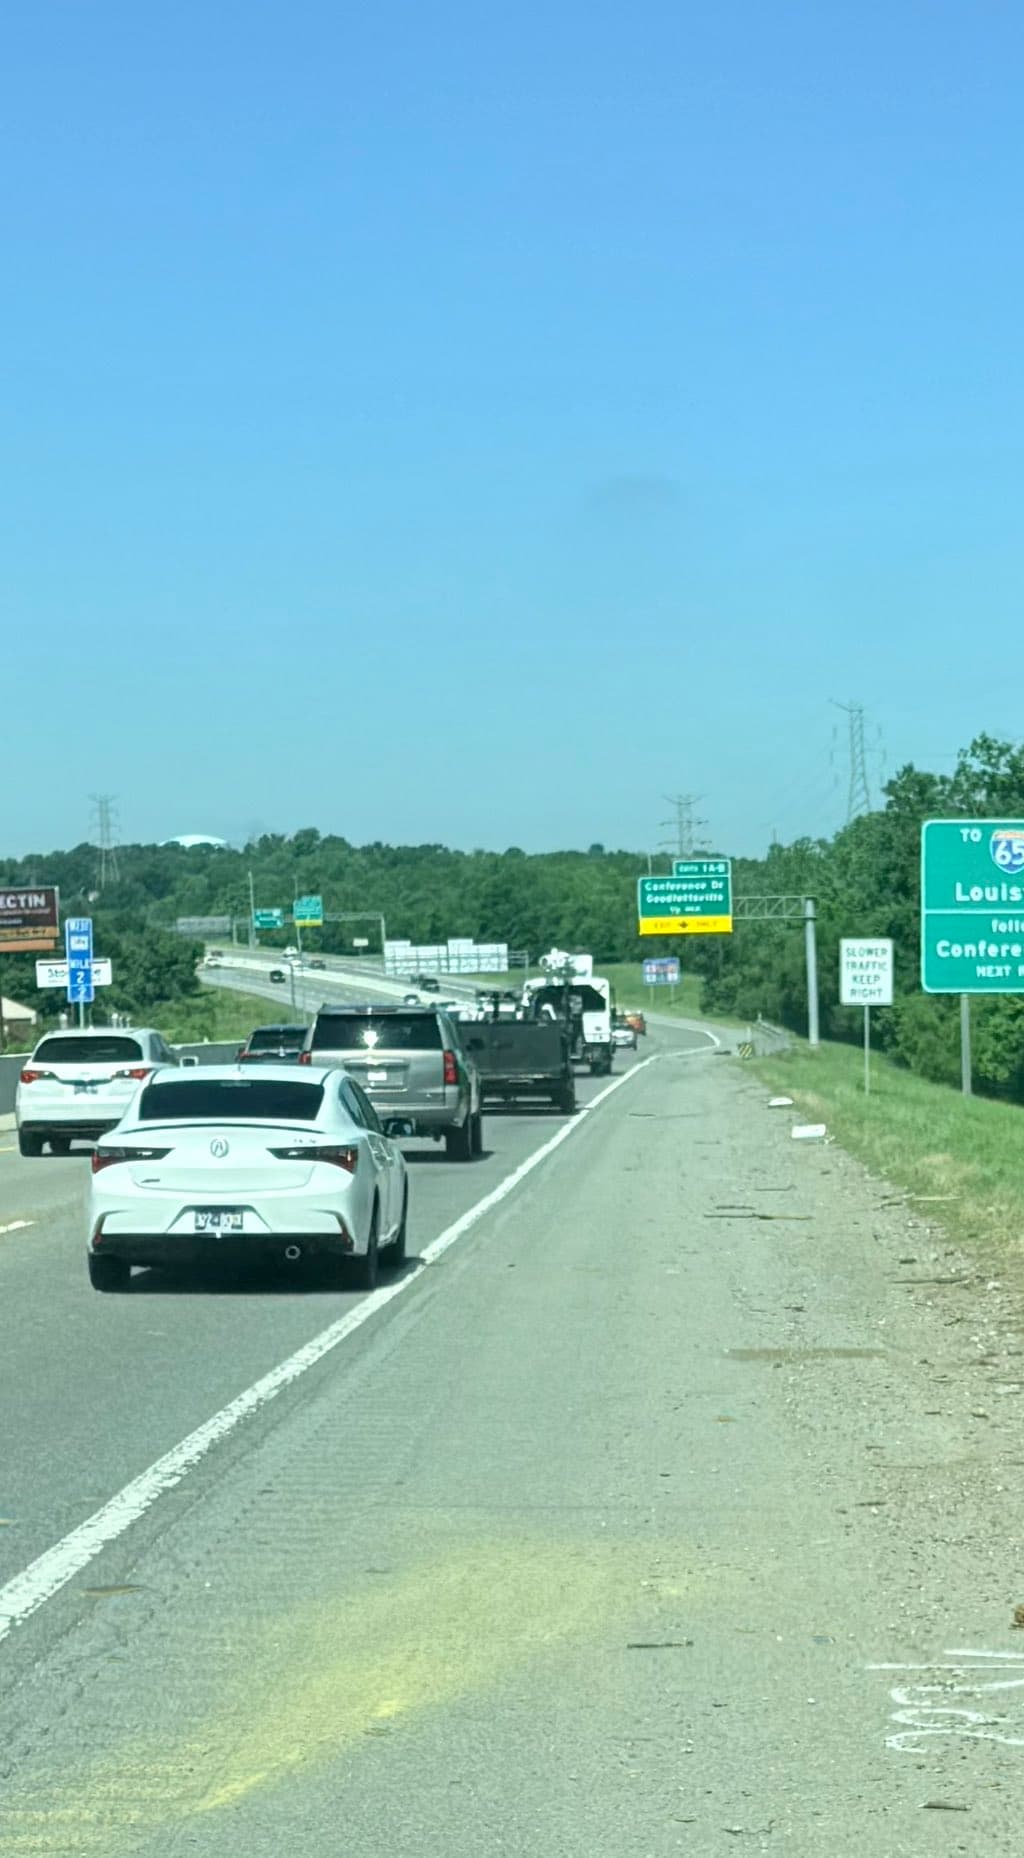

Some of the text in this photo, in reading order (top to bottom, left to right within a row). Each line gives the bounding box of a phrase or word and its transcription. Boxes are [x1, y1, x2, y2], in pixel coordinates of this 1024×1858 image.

[960, 828, 983, 842] TO
[644, 880, 724, 892] Conference Dr
[846, 946, 888, 958] SLOWER
[846, 960, 888, 972] TRAFFIC
[976, 965, 1011, 977] NEXT
[76, 970, 85, 984] 2
[852, 974, 881, 985] KEEP
[850, 988, 883, 999] RIGHT
